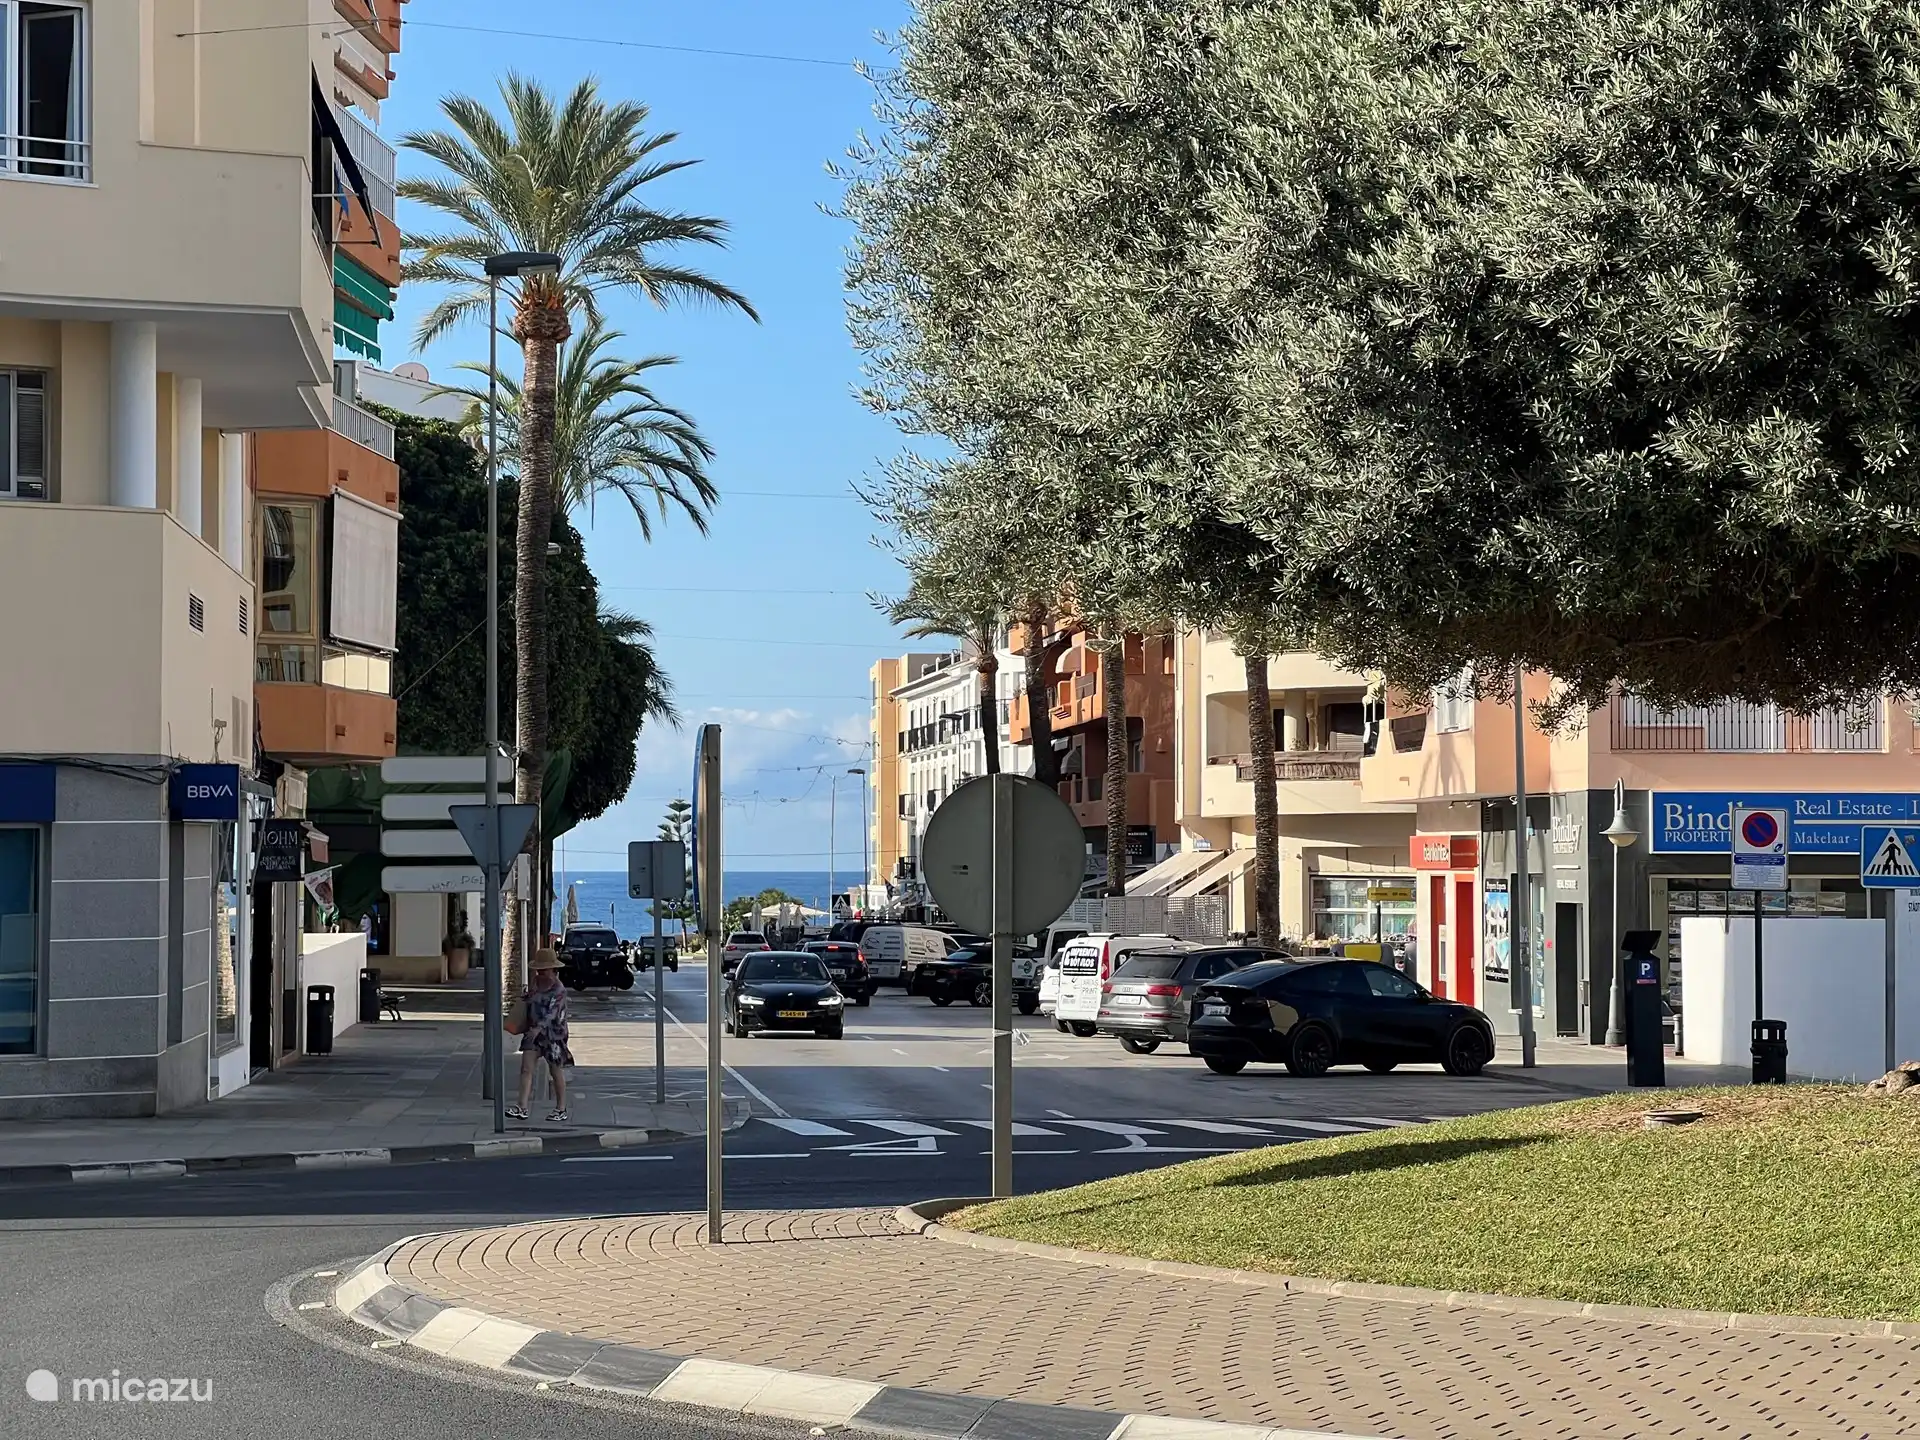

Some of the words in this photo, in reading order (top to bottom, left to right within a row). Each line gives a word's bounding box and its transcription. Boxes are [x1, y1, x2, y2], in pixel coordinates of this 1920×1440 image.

[187, 785, 233, 798] BBVA
[1794, 800, 1832, 815] Real
[1837, 800, 1892, 815] Estate
[1663, 801, 1743, 831] Bind
[1665, 831, 1732, 842] PROPERTI
[1794, 832, 1850, 844] Makelaar
[1641, 963, 1651, 976] P
